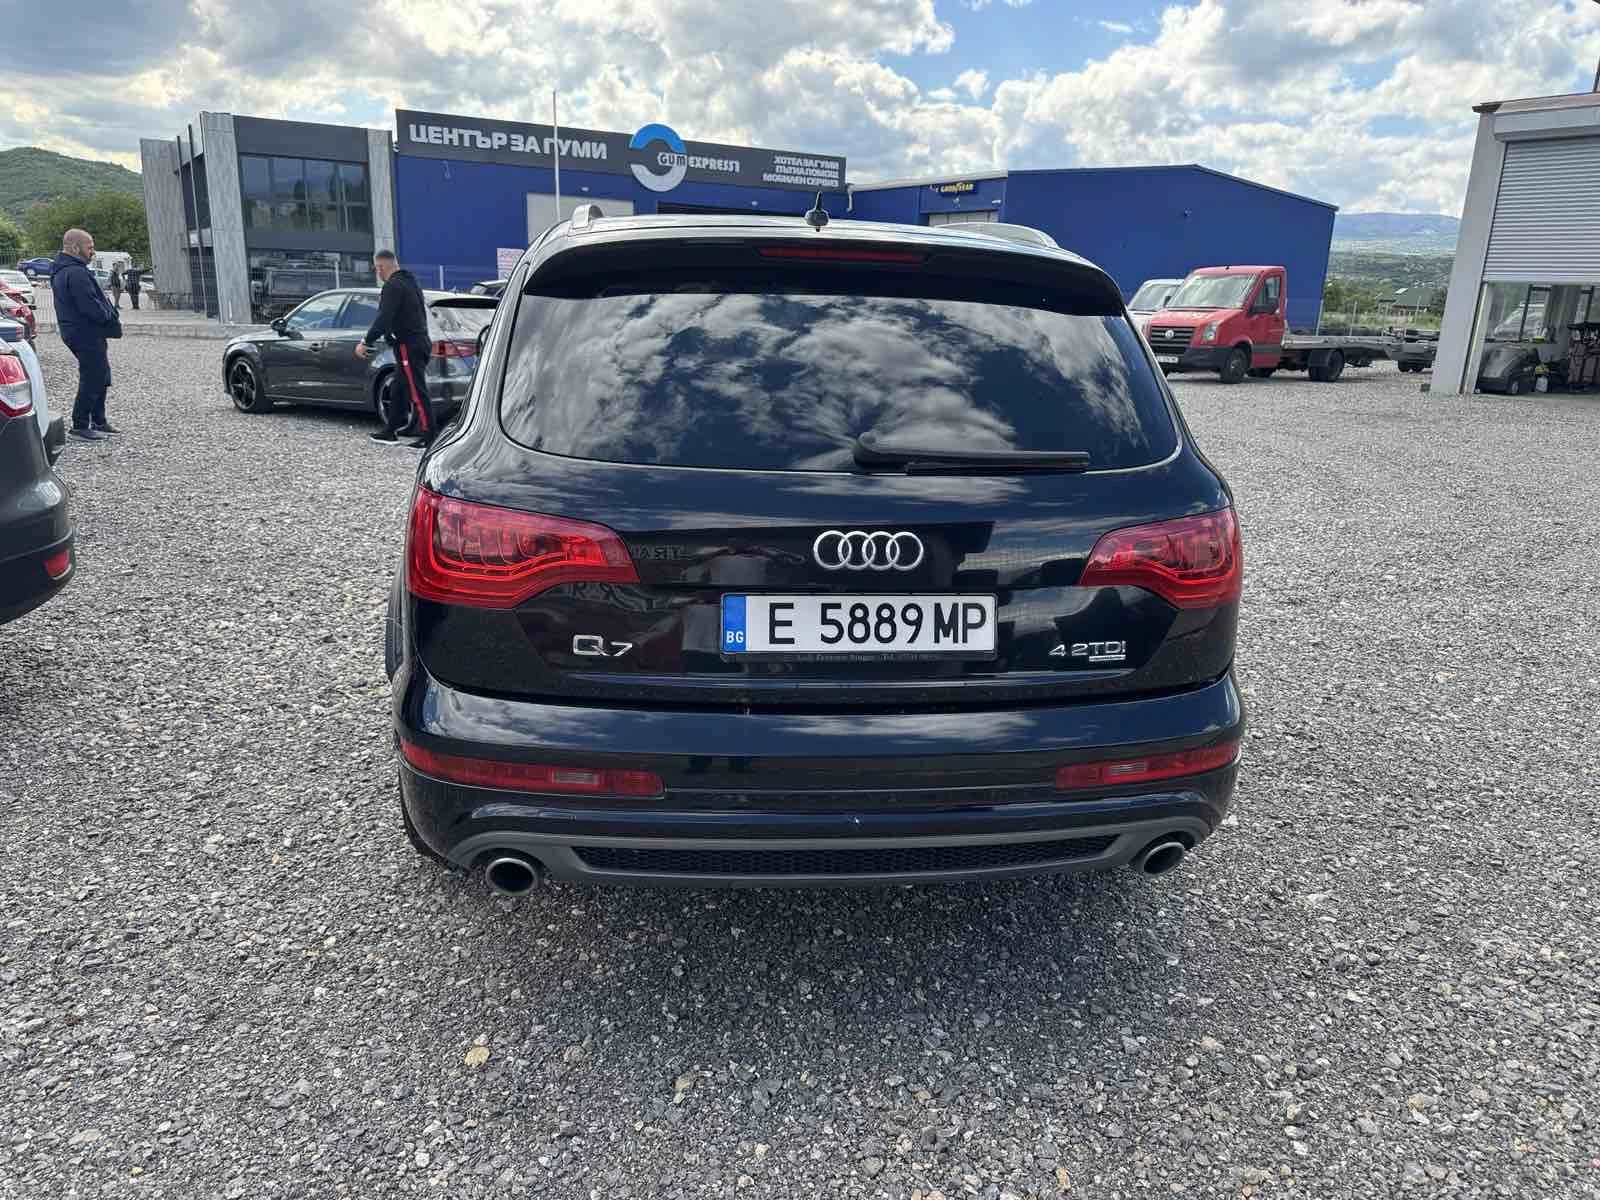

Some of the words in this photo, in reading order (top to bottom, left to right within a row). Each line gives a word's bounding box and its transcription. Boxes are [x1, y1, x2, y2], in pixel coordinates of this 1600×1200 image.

[409, 124, 508, 150] ЦЕНТЪР
[509, 134, 541, 154] ЗА
[543, 137, 608, 160] ГУМИ
[725, 631, 745, 644] BG
[768, 602, 796, 645] E
[819, 602, 924, 645] 5889
[933, 602, 987, 645] MP
[572, 634, 633, 657] Q7
